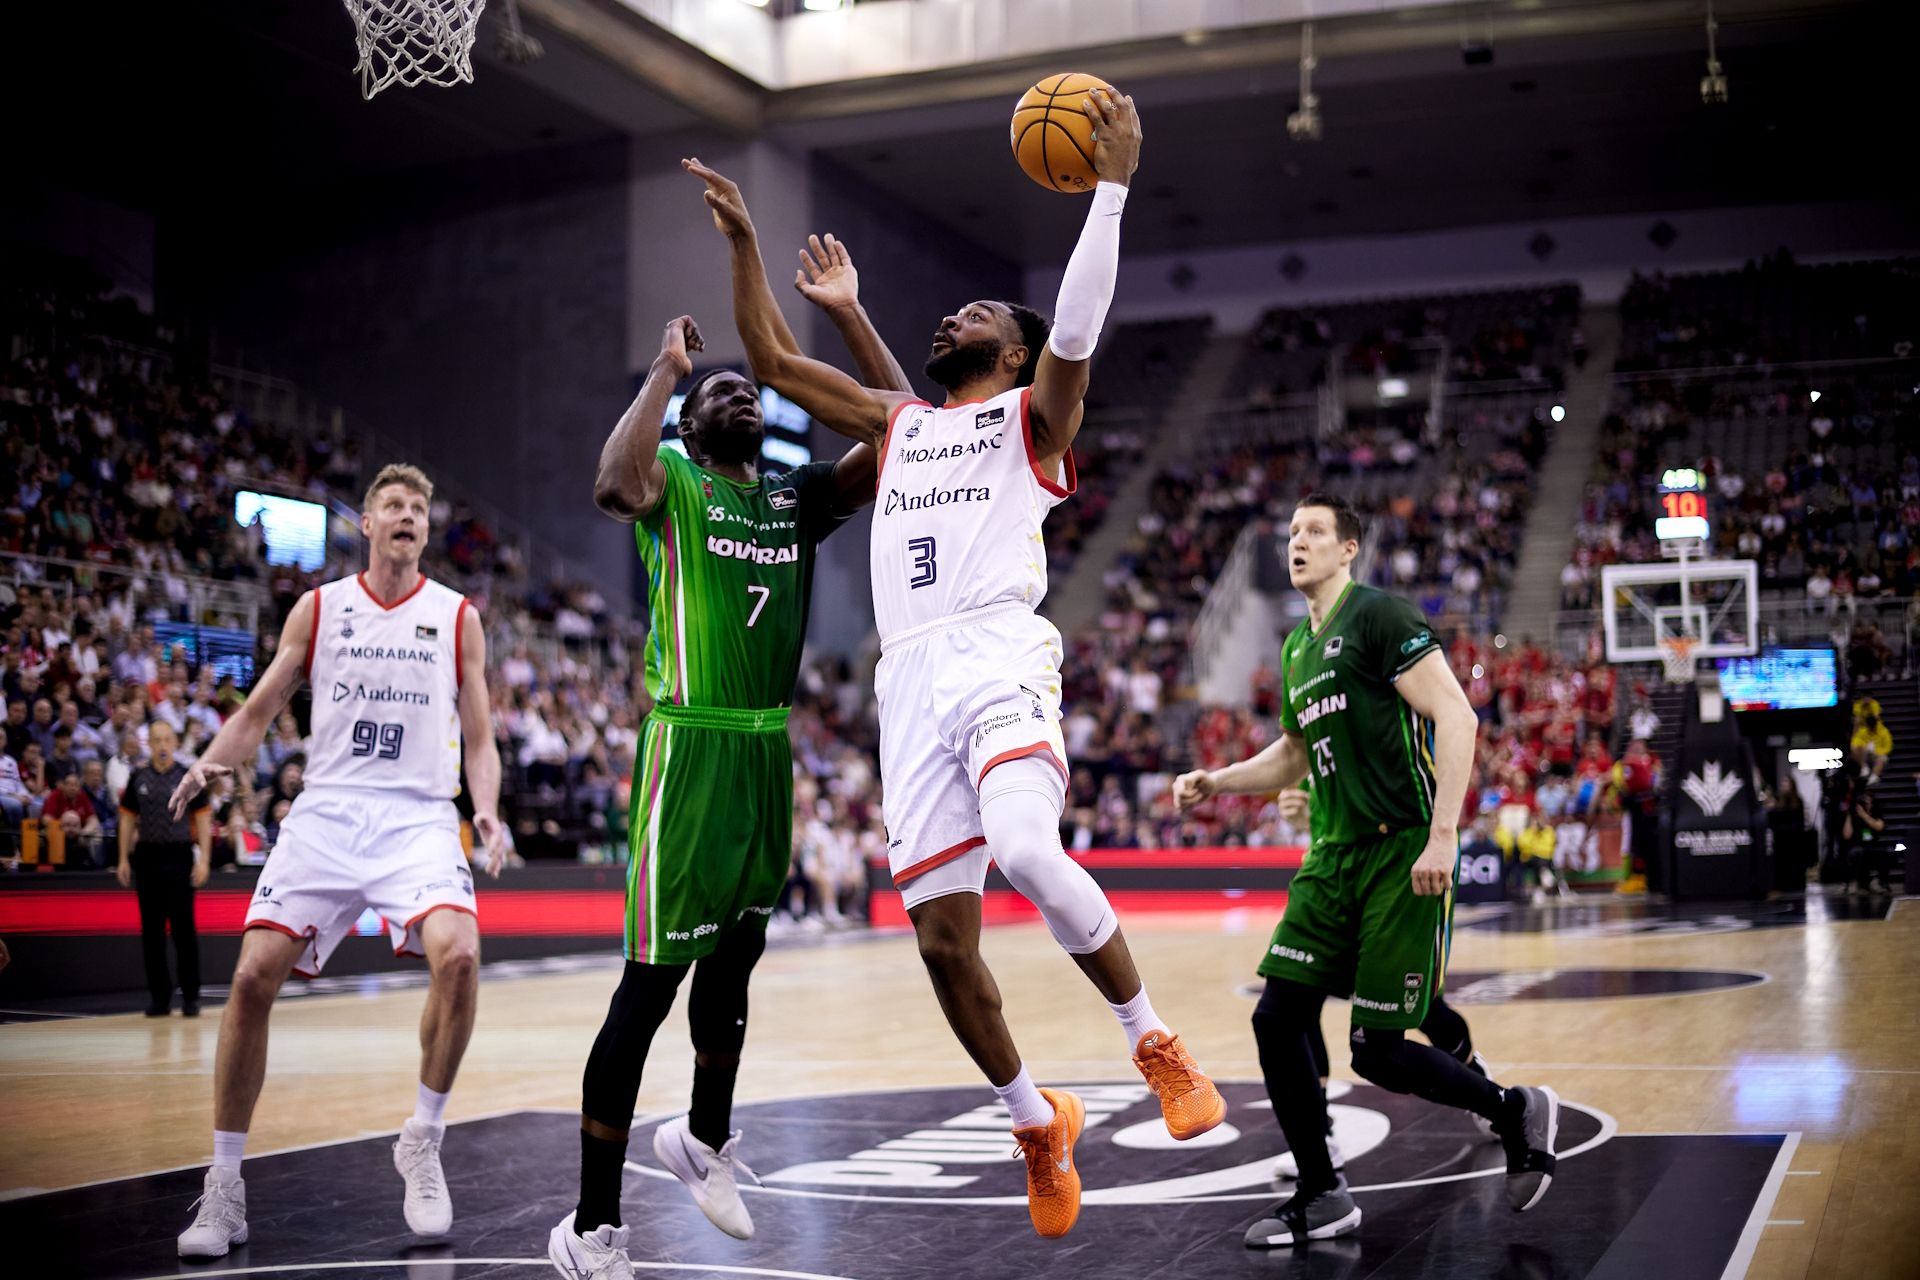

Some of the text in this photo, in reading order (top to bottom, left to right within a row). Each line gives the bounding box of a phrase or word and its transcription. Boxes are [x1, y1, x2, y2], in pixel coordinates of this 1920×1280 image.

[900, 486, 991, 511] Andorra
[1662, 492, 1698, 518] 10
[908, 536, 937, 590] 3
[746, 585, 770, 628] 7
[350, 647, 439, 665] MORABANC
[353, 683, 430, 706] Andorra
[352, 720, 405, 761] 99
[666, 930, 690, 941] vive
